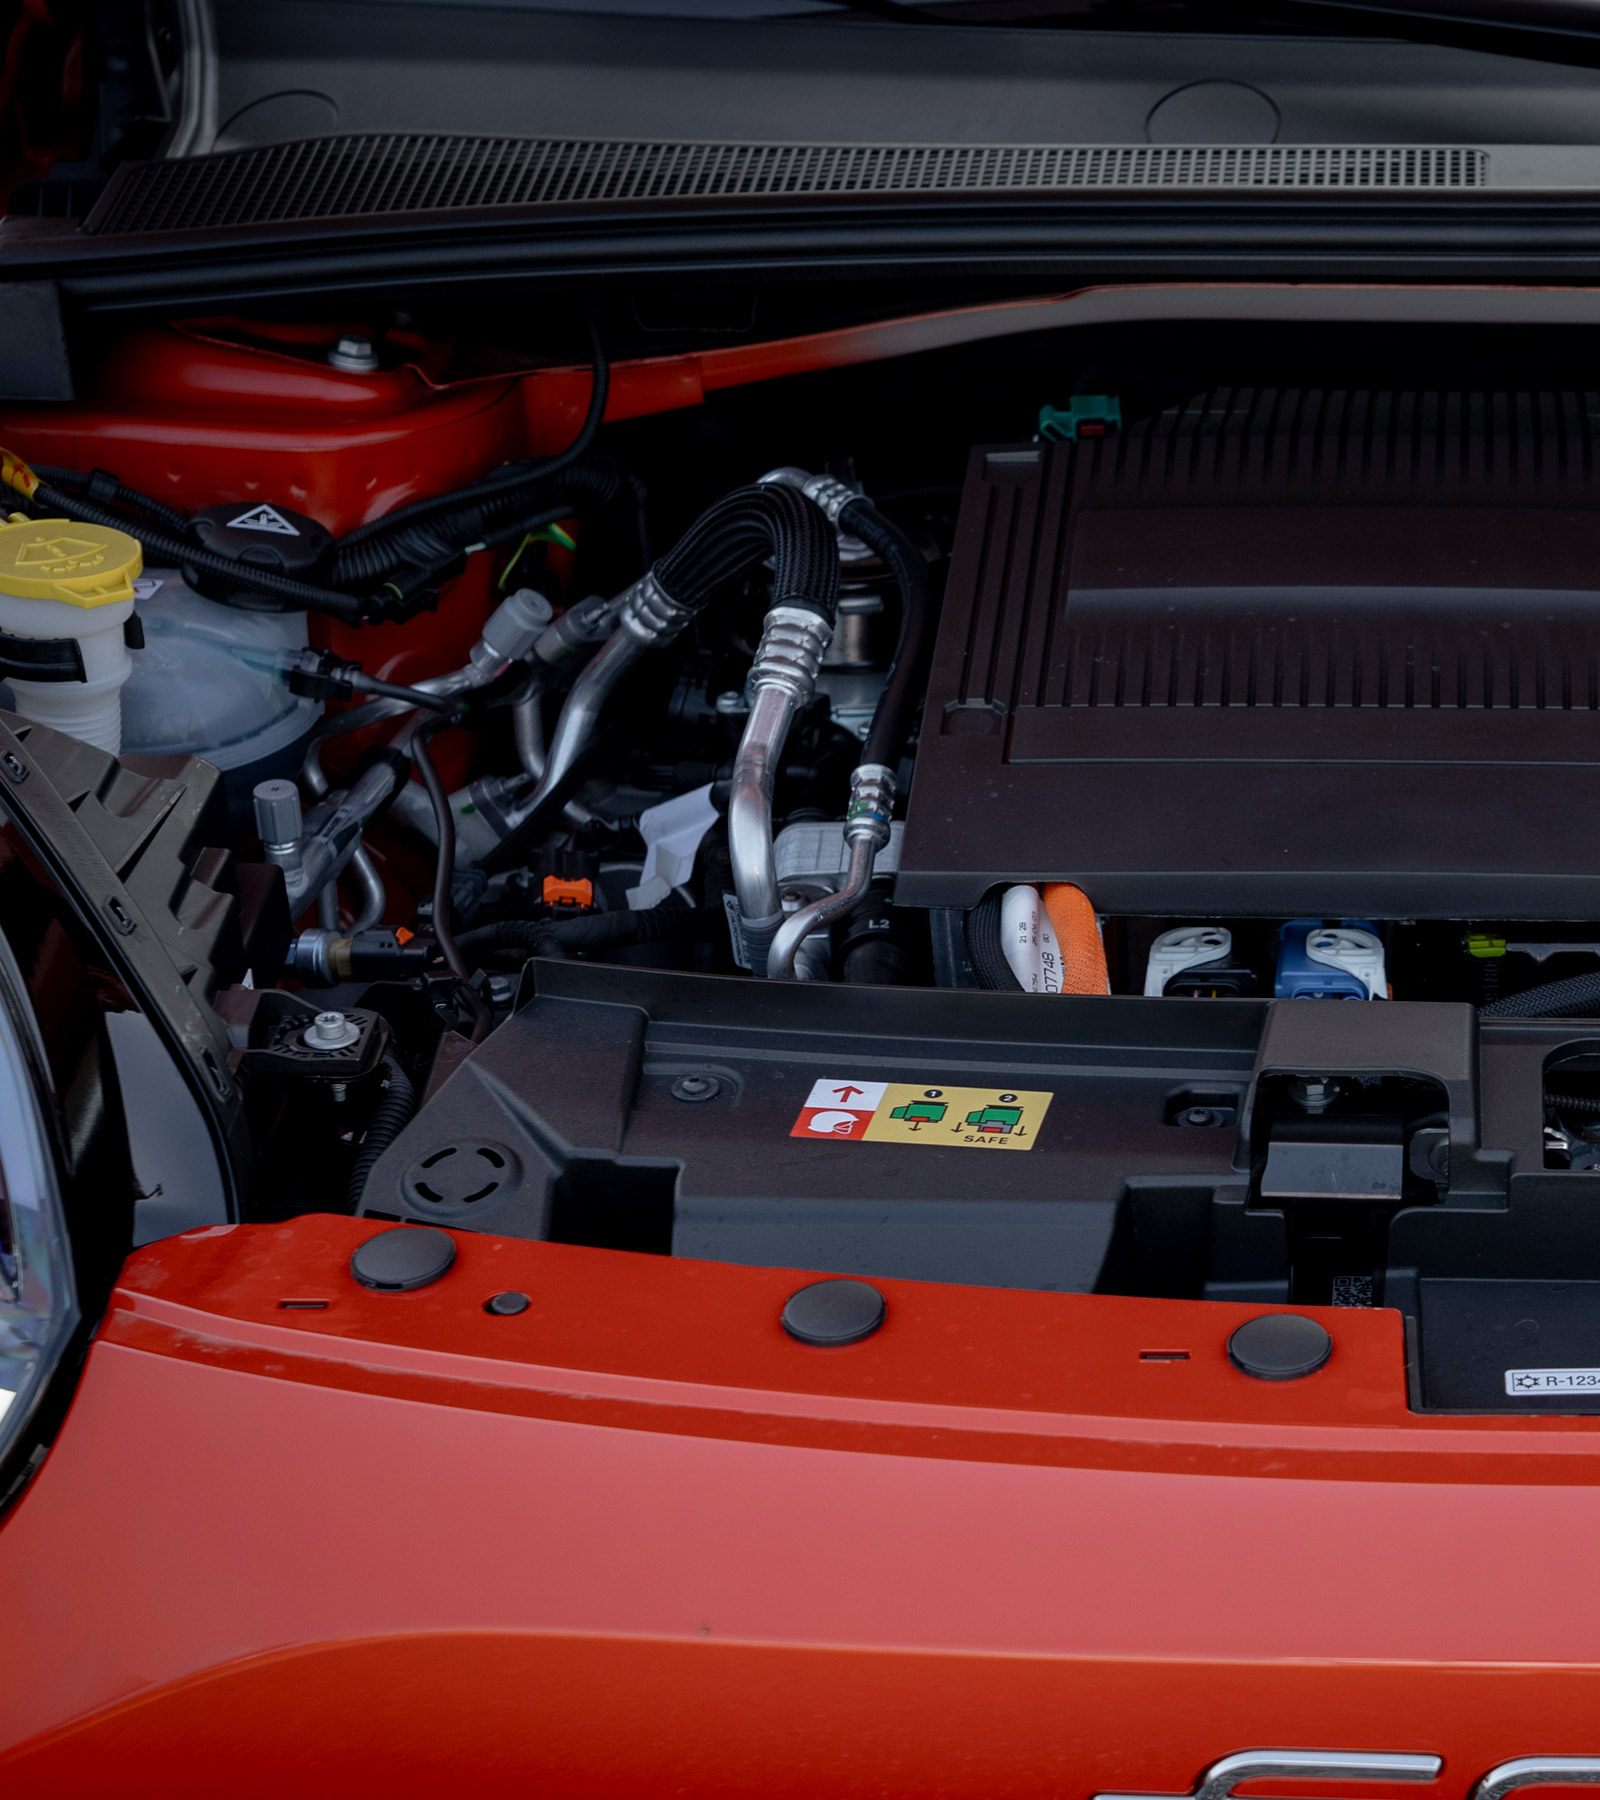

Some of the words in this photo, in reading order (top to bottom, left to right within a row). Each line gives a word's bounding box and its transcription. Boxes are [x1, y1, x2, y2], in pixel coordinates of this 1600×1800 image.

[868, 919, 890, 929] L2
[1002, 1094, 1013, 1102] 2
[963, 1135, 1009, 1145] SAFE
